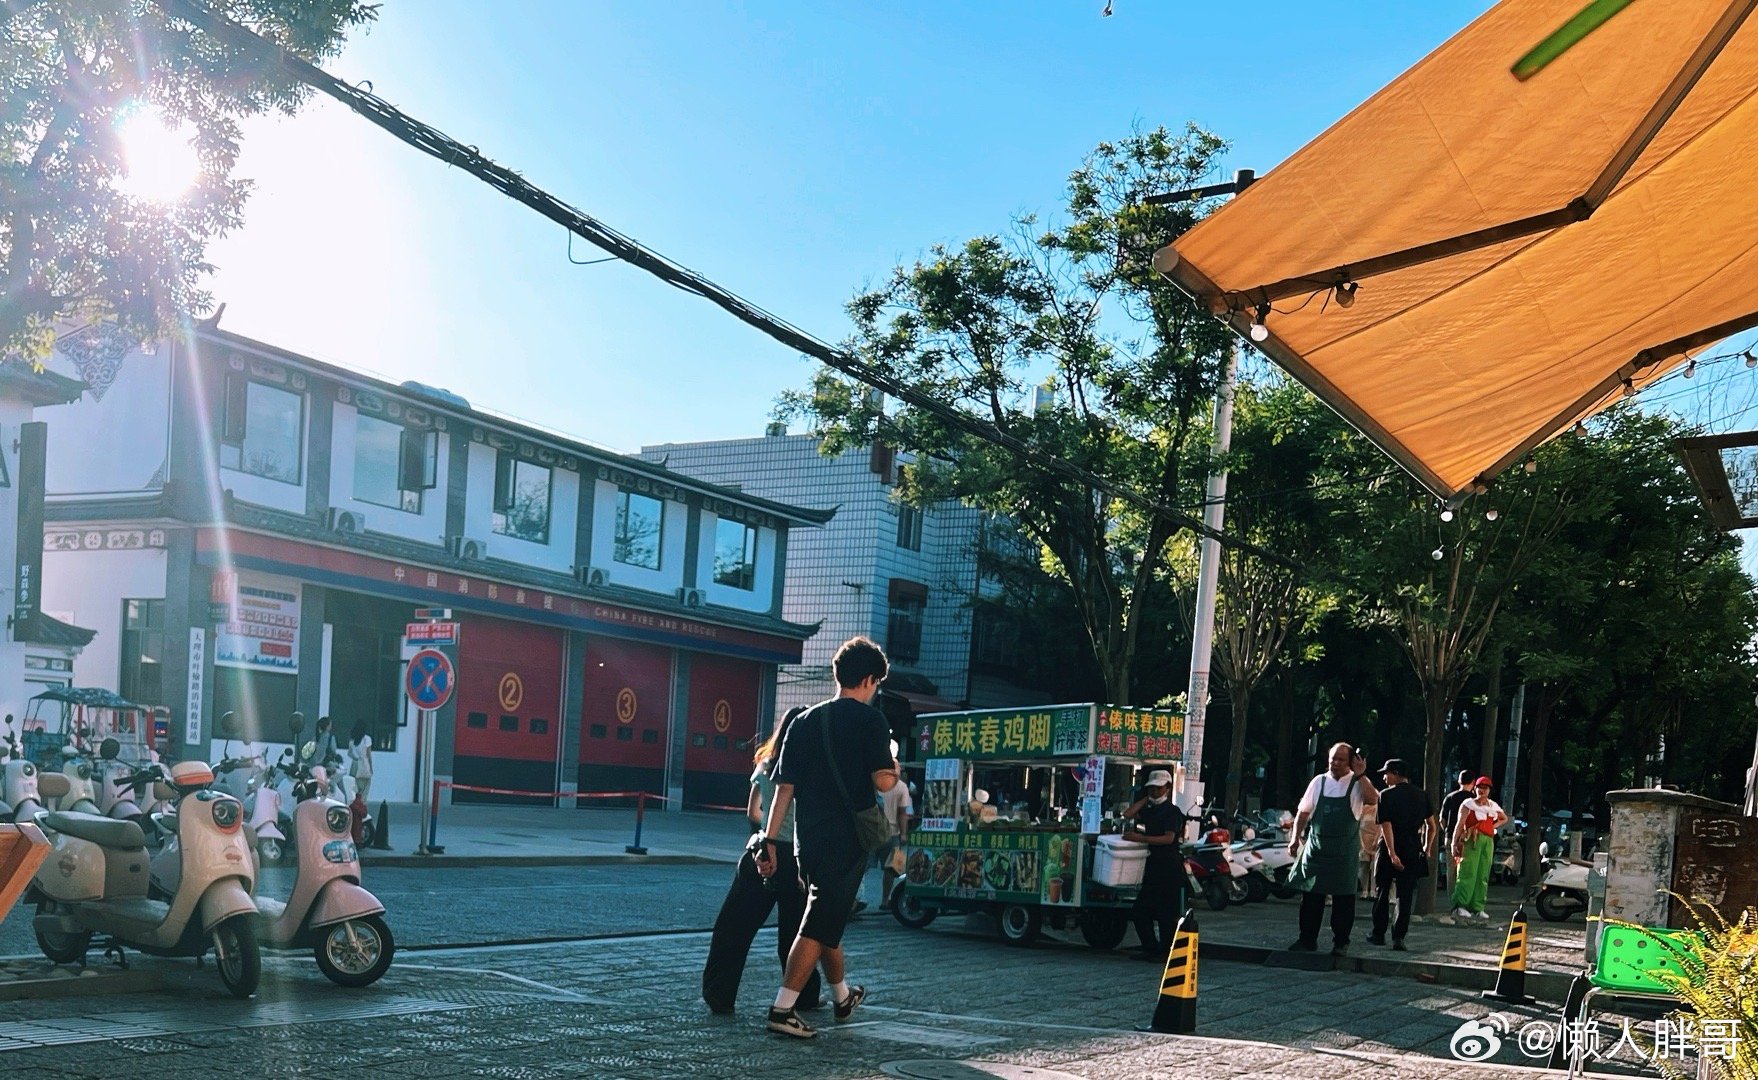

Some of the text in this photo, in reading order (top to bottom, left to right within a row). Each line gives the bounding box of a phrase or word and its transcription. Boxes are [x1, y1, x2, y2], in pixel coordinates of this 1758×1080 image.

[394, 566, 553, 610] 中国消防救援
[594, 607, 717, 638] CHINA FIRE AND RESCUE
[1061, 709, 1084, 727] 手打
[1055, 728, 1087, 752] 柠檬茶
[1097, 731, 1139, 755] 烤乳扇
[1086, 758, 1098, 792] 烤乳扇
